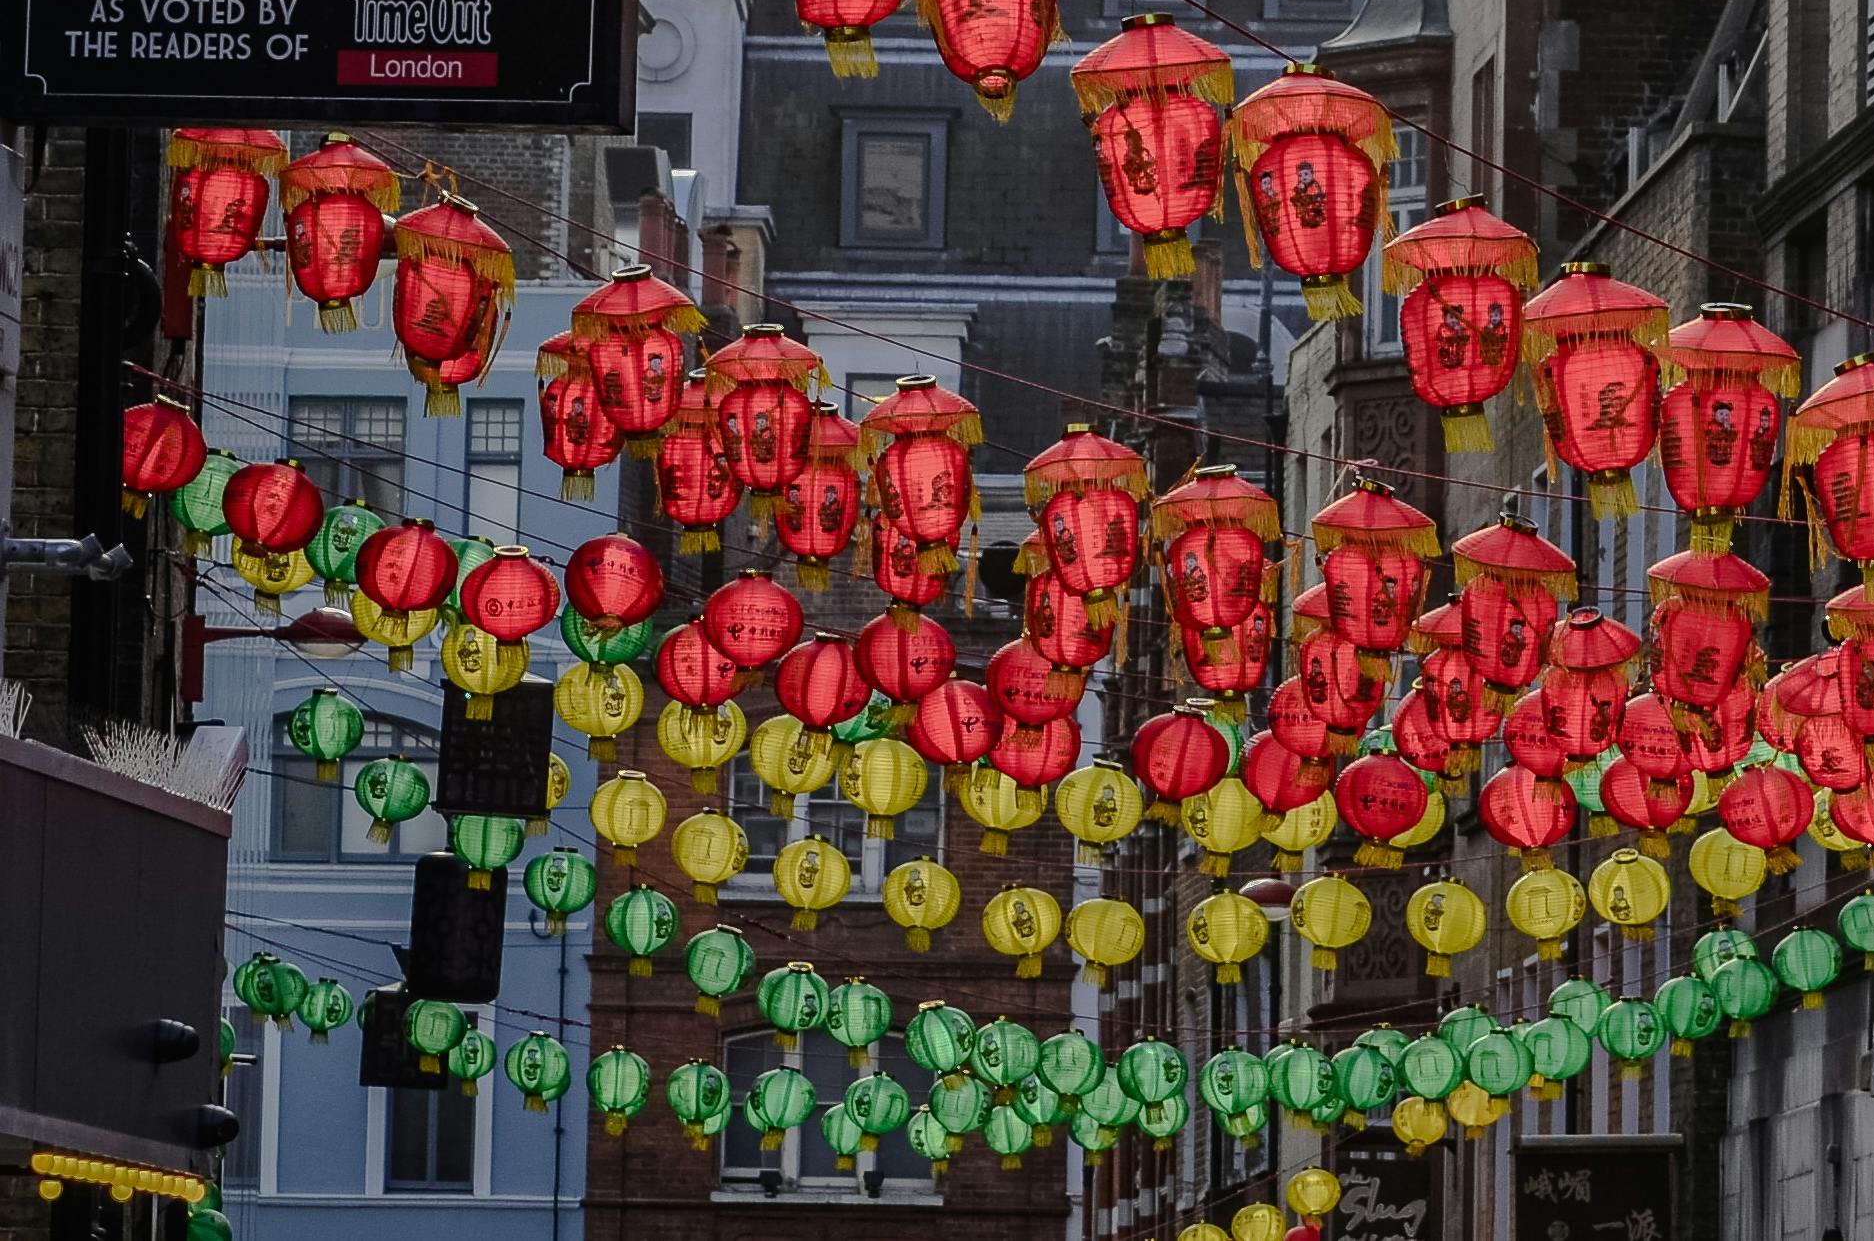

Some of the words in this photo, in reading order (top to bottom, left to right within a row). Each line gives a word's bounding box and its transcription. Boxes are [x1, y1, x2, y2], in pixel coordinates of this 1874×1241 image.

[65, 31, 118, 58] THE
[131, 31, 252, 60] READERS
[266, 33, 310, 62] OF
[370, 53, 463, 79] London
